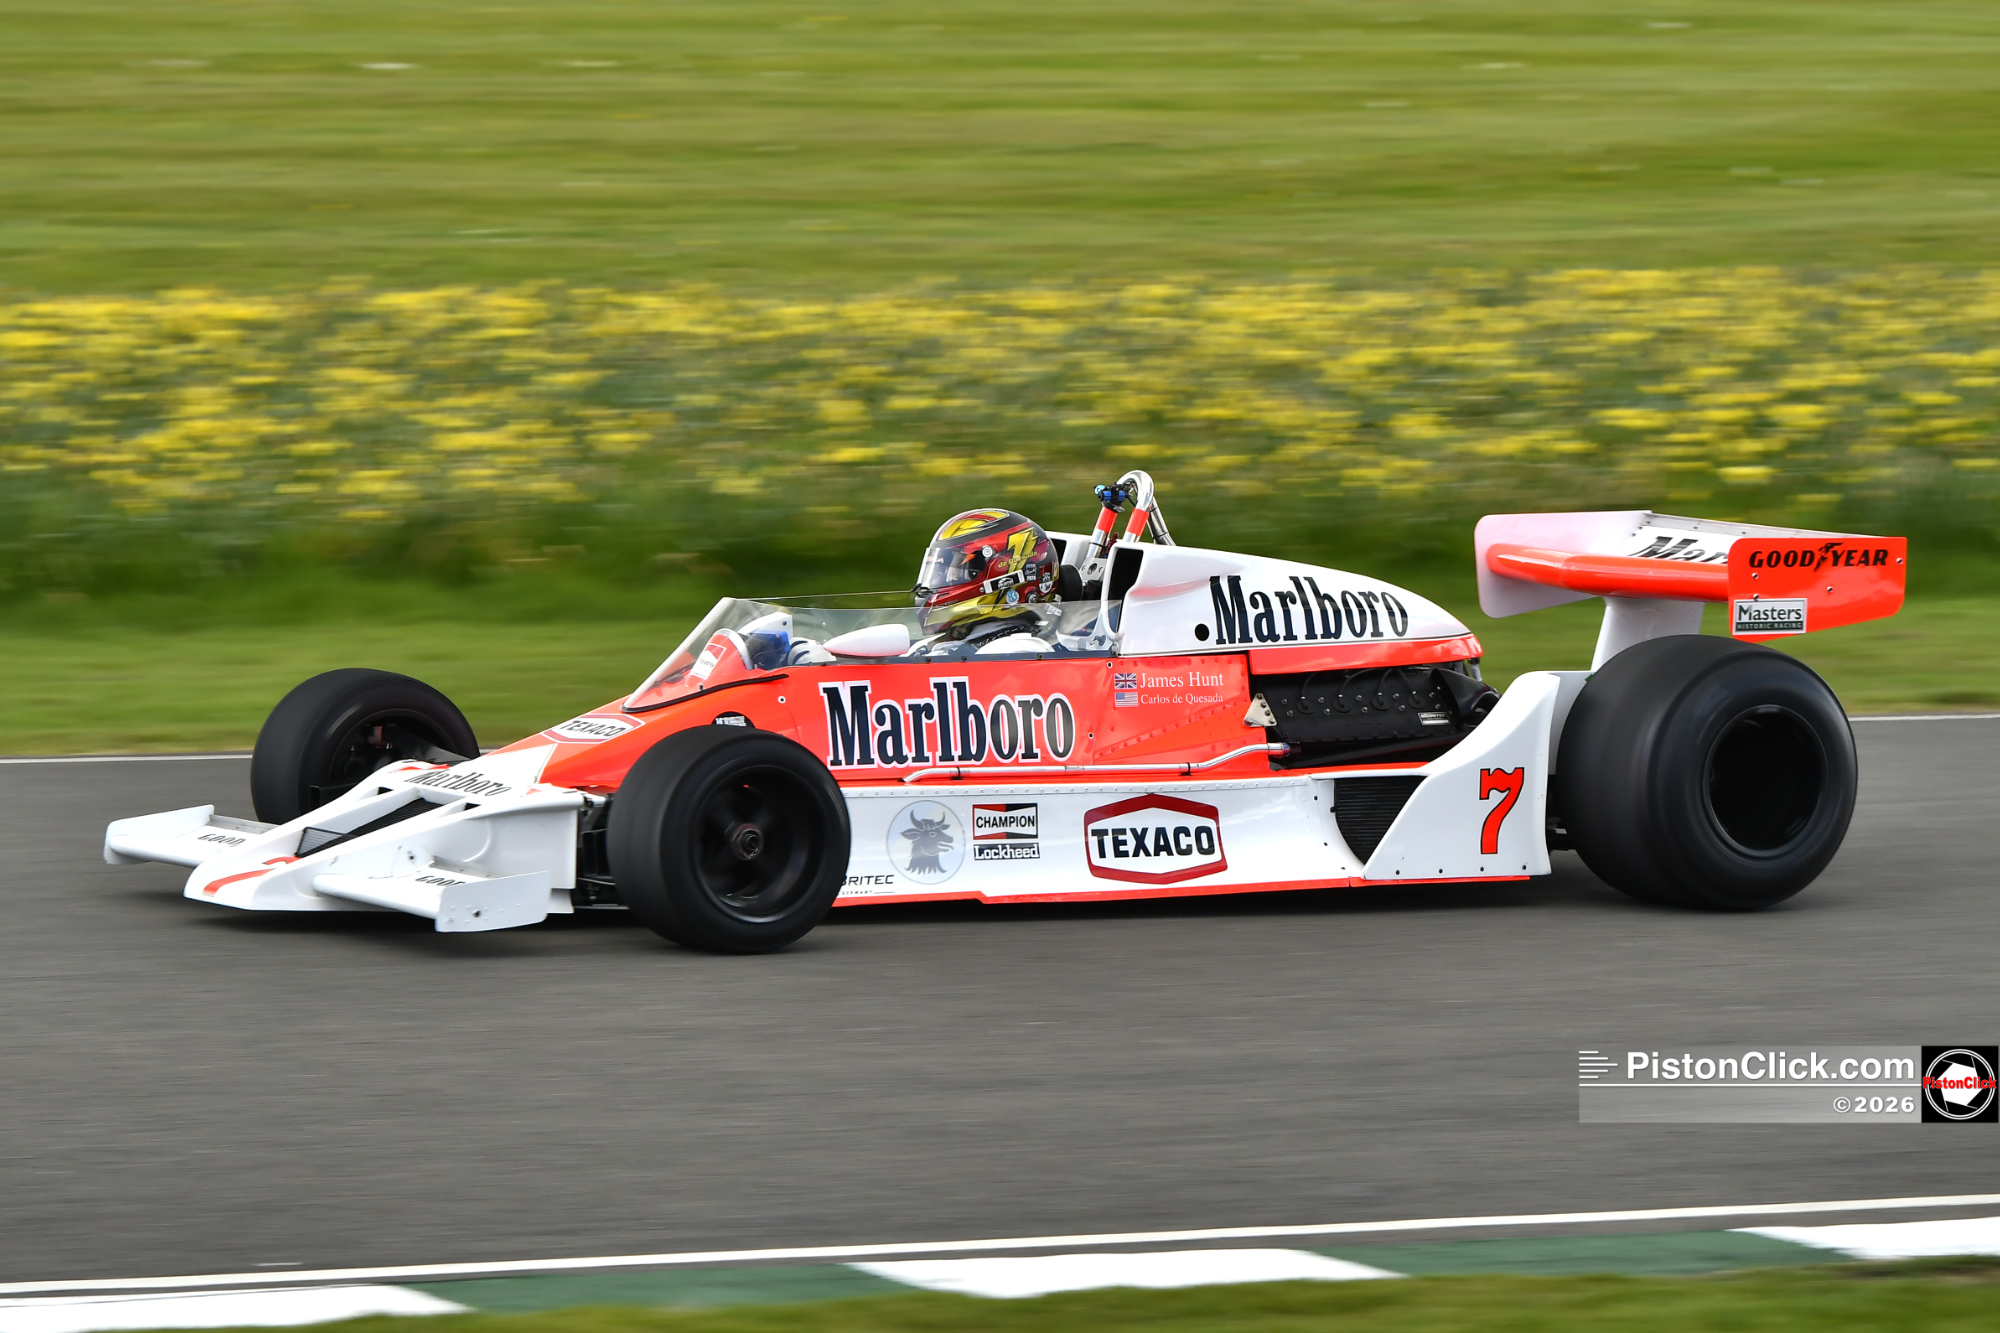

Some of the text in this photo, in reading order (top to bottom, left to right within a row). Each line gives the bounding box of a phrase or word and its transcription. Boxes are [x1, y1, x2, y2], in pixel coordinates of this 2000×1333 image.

[1209, 575, 1409, 645] Marlboro
[1738, 604, 1802, 621] Masters
[1140, 671, 1224, 688] James Hunt
[1140, 692, 1224, 705] Carlos de Quesada
[560, 719, 627, 737] TEXACO
[819, 677, 1075, 768] Marlboro
[403, 769, 512, 796] Marlboro
[1479, 767, 1525, 855] 7
[976, 815, 1035, 829] CHAMPION
[1091, 825, 1215, 859] TEXACO
[974, 844, 1039, 860] Lockheed
